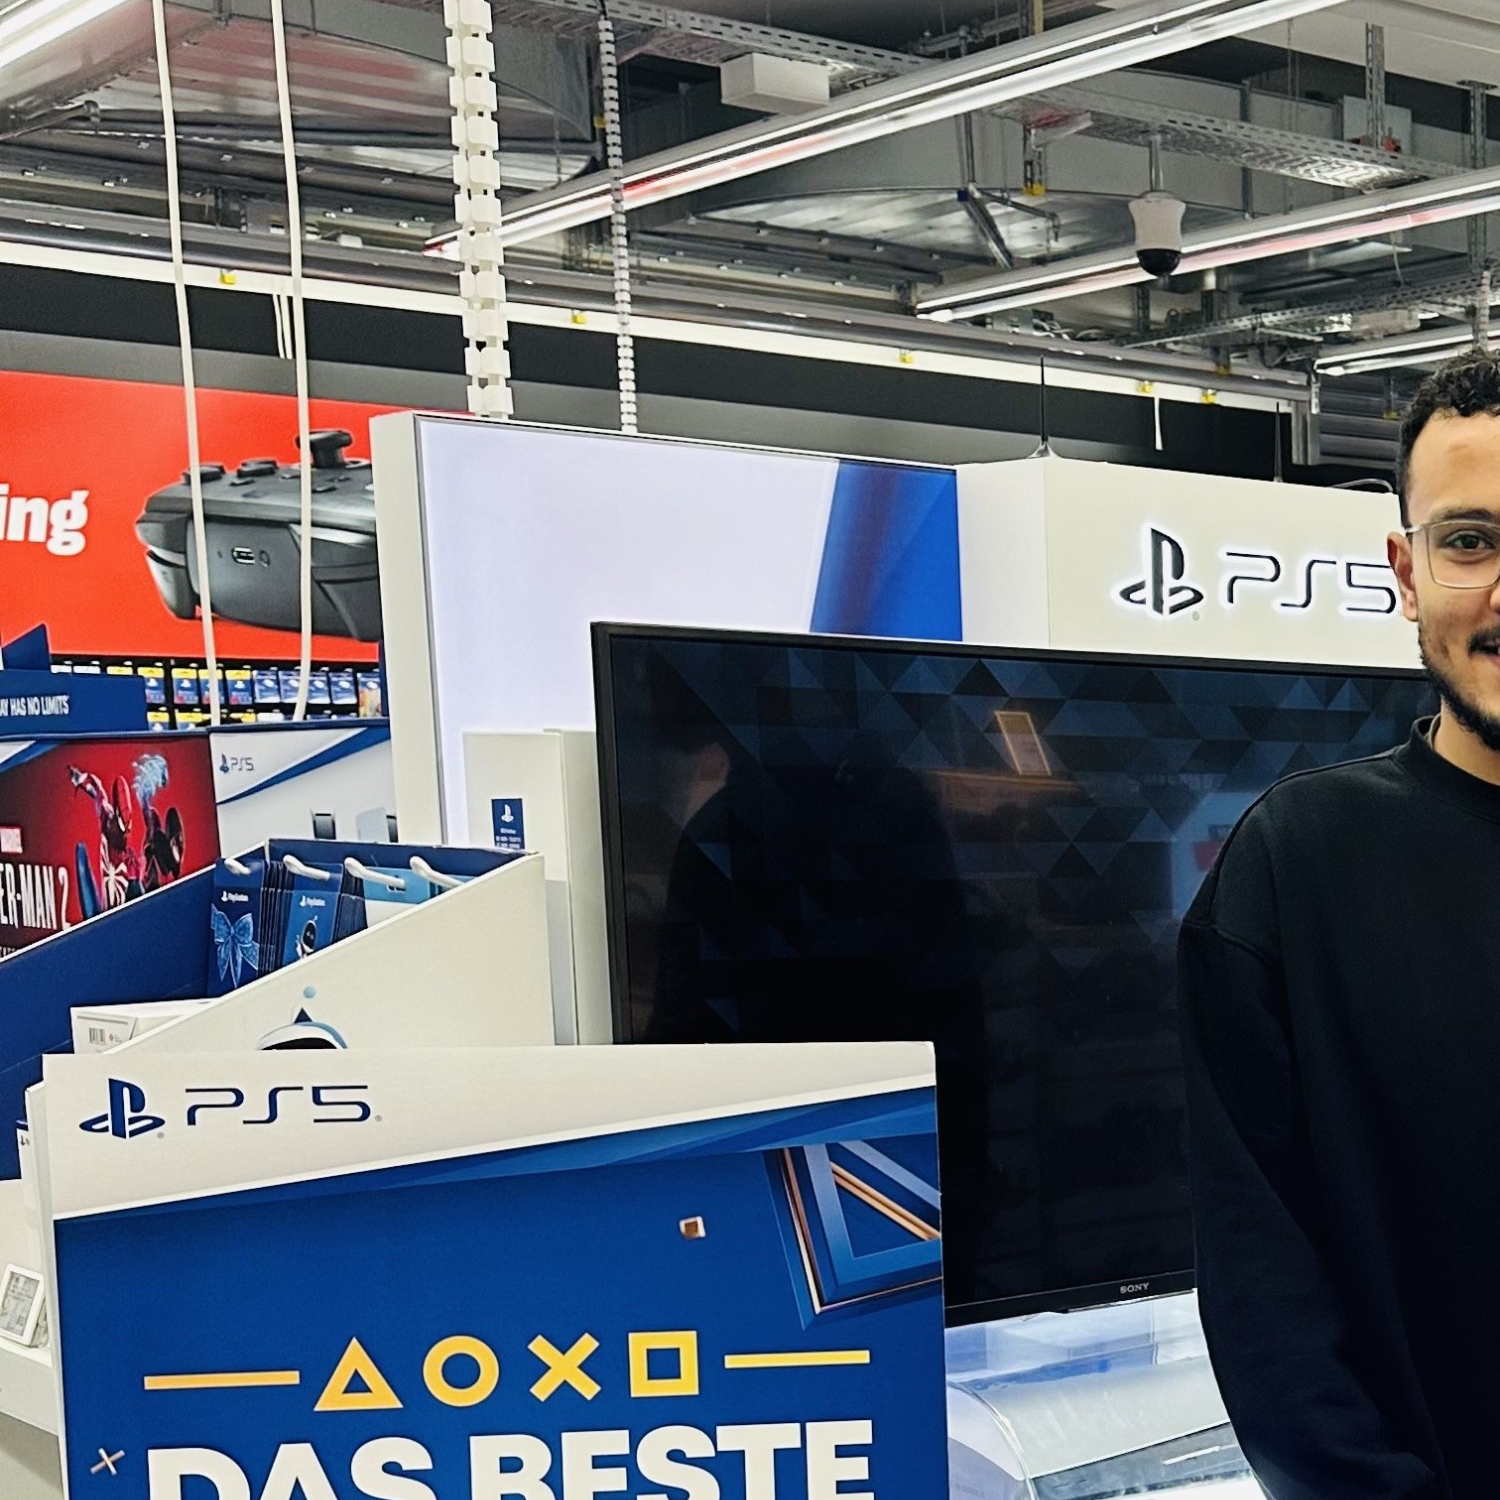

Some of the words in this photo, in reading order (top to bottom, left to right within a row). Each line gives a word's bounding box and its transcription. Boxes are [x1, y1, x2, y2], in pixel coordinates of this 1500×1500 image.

[0, 484, 88, 556] ing
[1226, 551, 1397, 614] PS5
[10, 697, 26, 716] HAS
[27, 696, 40, 716] NO
[40, 695, 70, 715] LIMITS
[230, 757, 254, 771] PS5
[58, 866, 71, 931] 2
[186, 1084, 371, 1125] PS5
[1120, 1282, 1149, 1294] SONY
